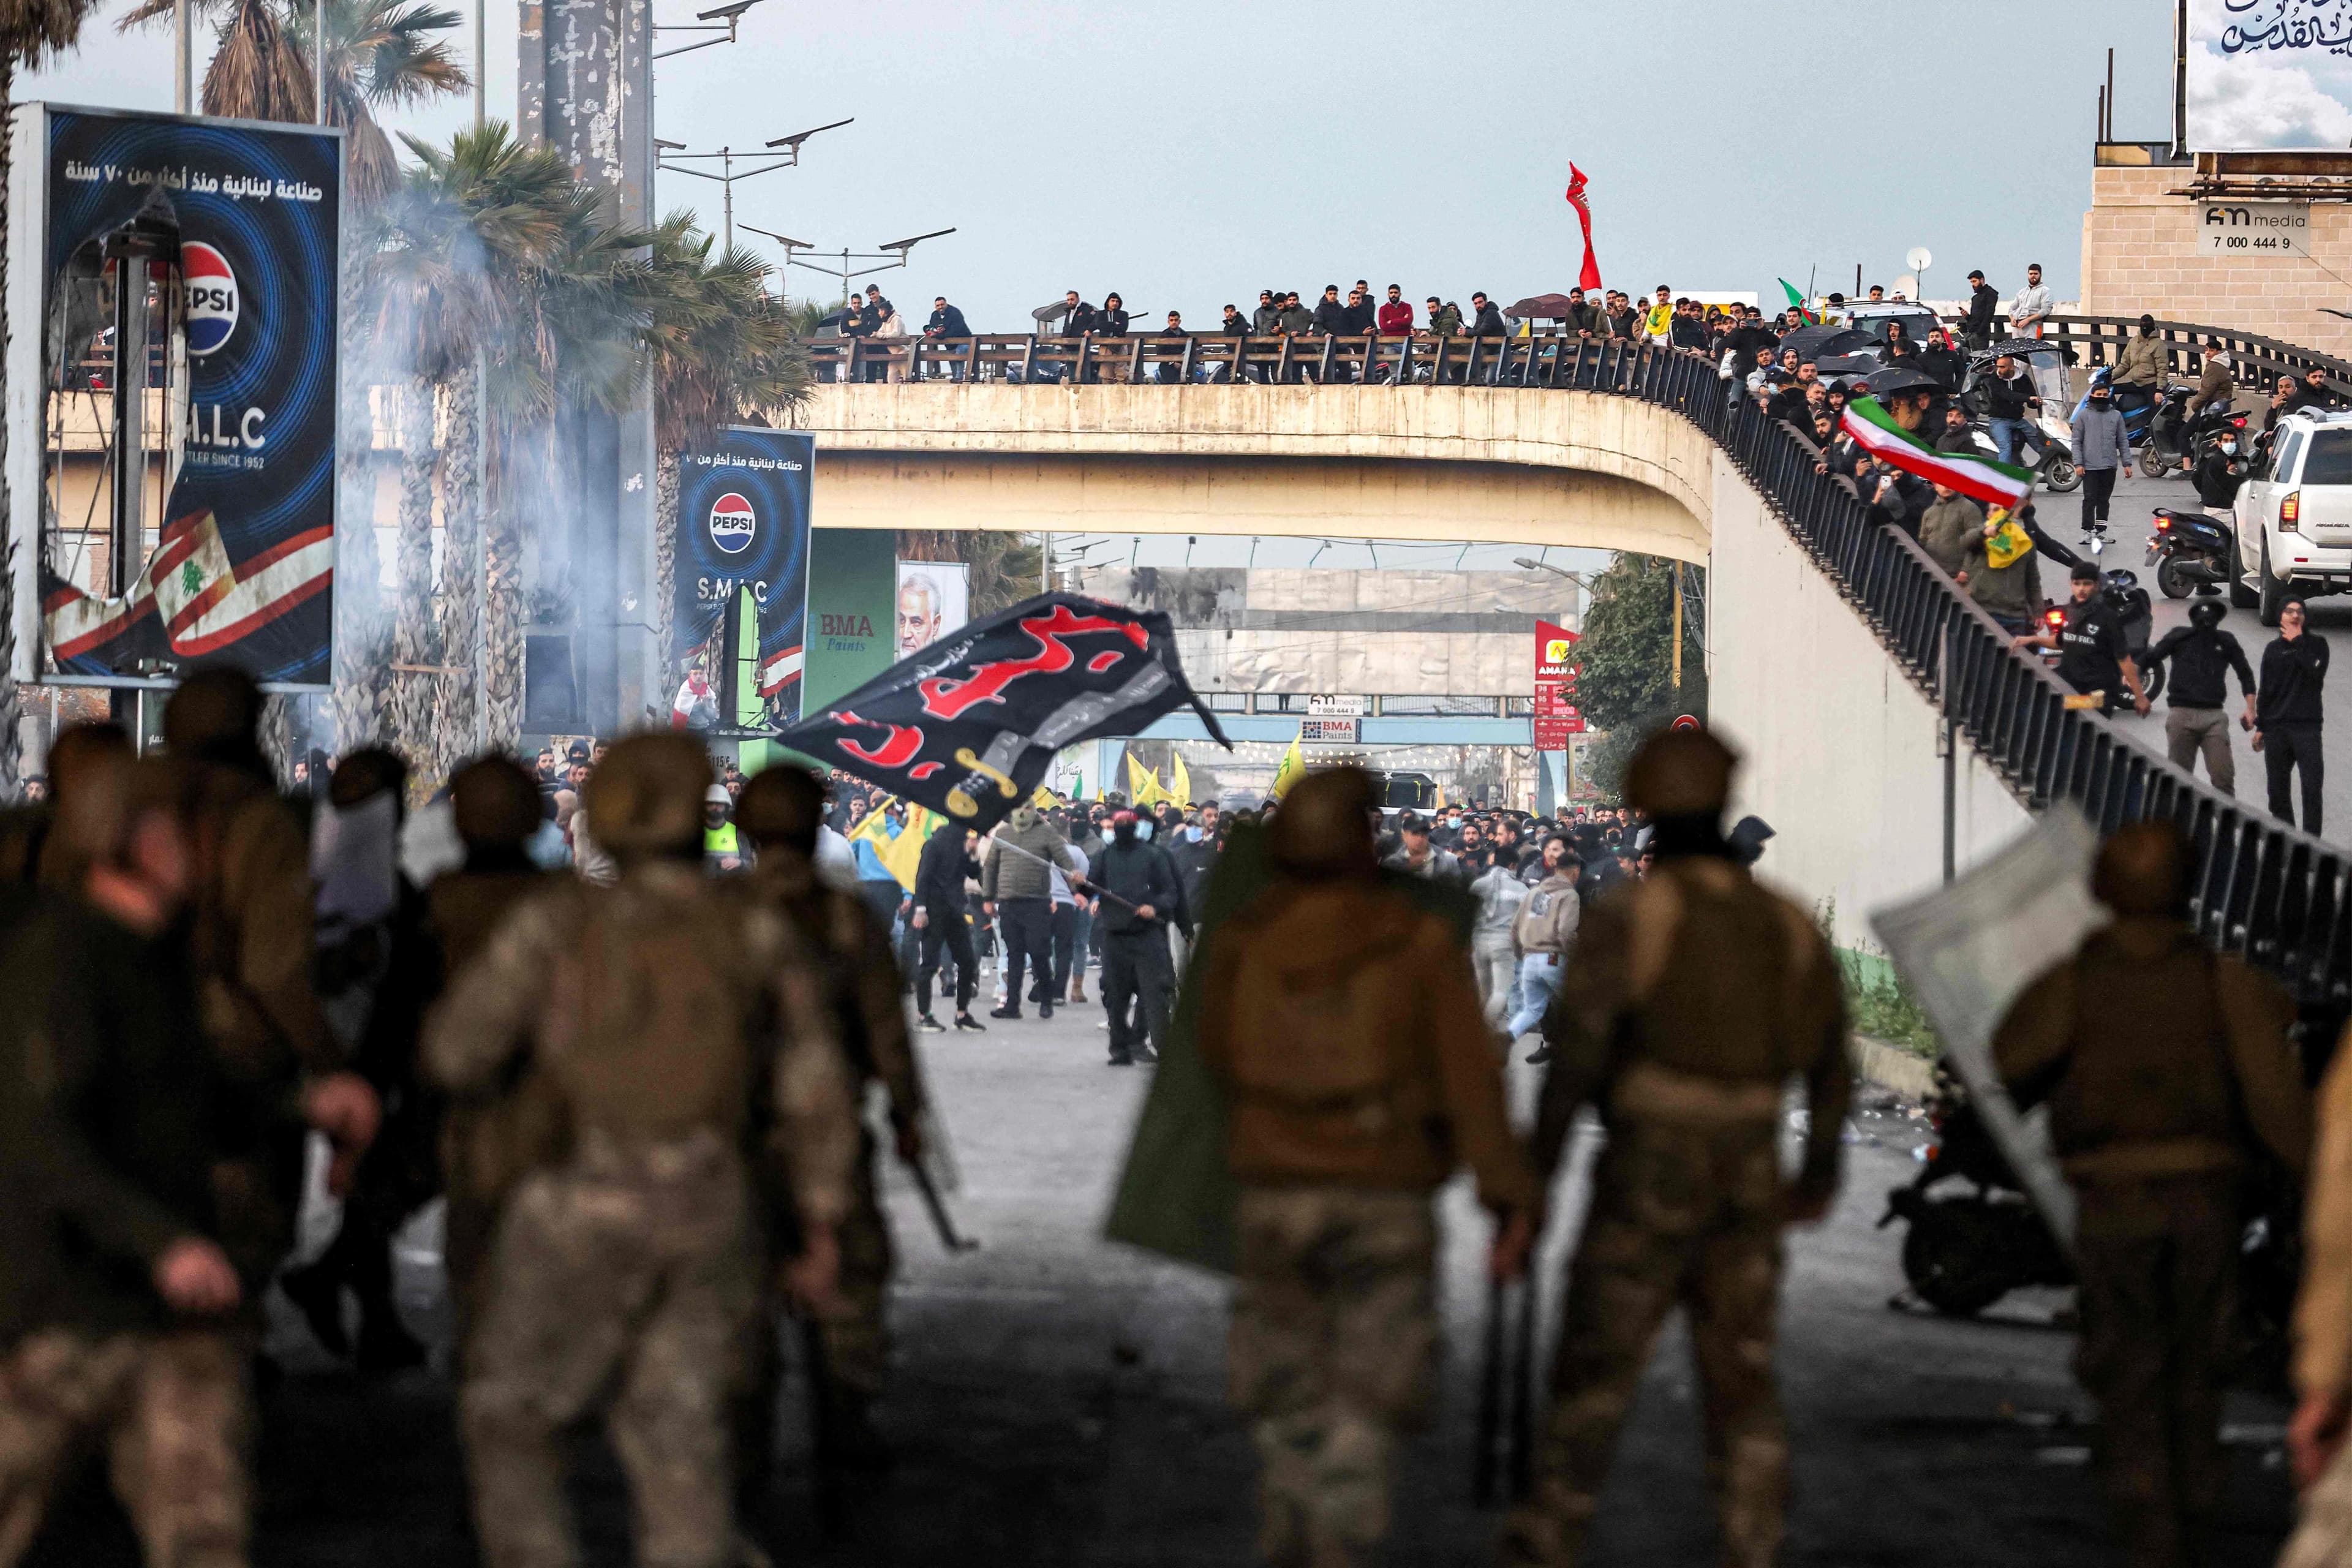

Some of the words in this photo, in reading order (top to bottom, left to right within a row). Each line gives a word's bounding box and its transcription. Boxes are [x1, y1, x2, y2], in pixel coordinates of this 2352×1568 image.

[66, 160, 100, 181] سنة
[127, 167, 152, 186] من
[191, 172, 219, 192] منذ
[222, 174, 272, 202] لبنانية
[276, 178, 323, 202] صناعة
[2254, 215, 2305, 227] media
[2214, 236, 2221, 247] 7
[2227, 236, 2248, 247] 000
[2253, 237, 2277, 249] 444
[2282, 238, 2290, 249] 9
[212, 452, 241, 467] SINCE
[244, 456, 265, 469] 1952
[697, 454, 711, 465] من
[712, 452, 729, 467] أكثر
[732, 455, 747, 467] منذ
[748, 455, 775, 472] لبنانية
[777, 459, 802, 471] صناعة
[713, 516, 753, 531] PEPSI
[821, 614, 875, 637] BMA
[826, 638, 865, 651] Paints
[1322, 721, 1352, 731] BMA
